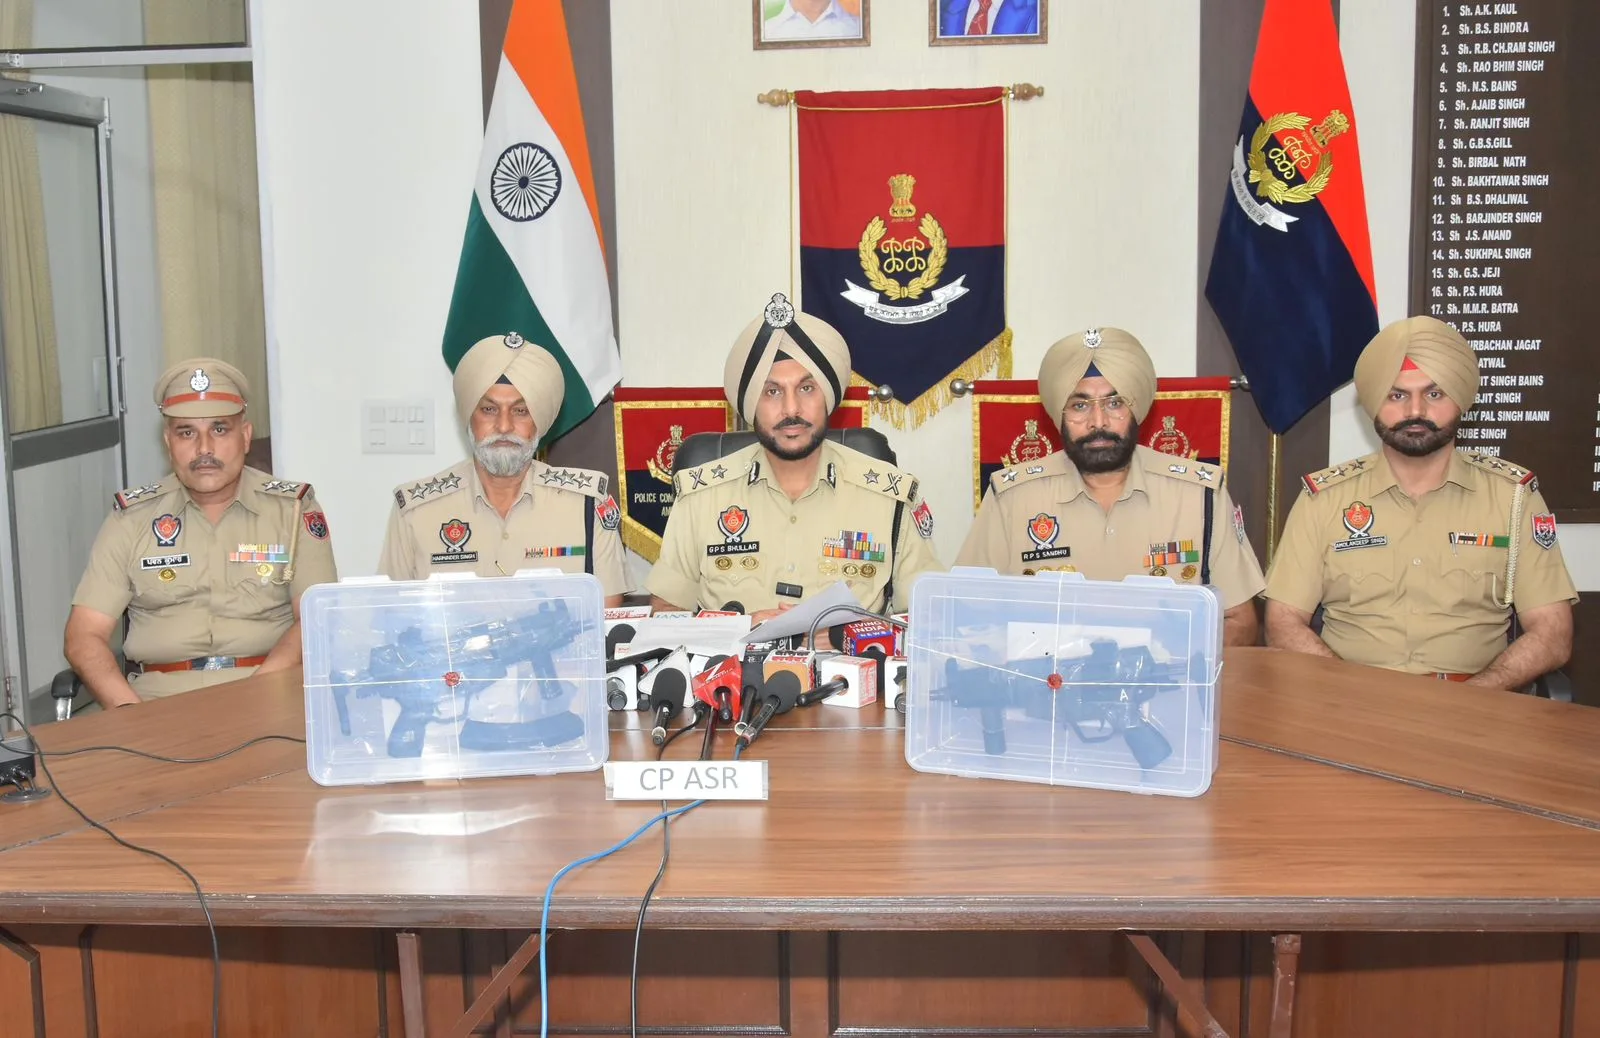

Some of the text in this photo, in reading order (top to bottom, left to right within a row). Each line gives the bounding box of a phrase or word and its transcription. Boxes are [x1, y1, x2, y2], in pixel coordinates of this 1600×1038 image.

[1443, 4, 1517, 17] 1. Sh. A.K. KAUL
[1442, 22, 1529, 35] 2. Sh. B.S. BINDRA
[1441, 41, 1555, 55] 3. Sh. R.B. CH.RAM SINGH
[1440, 60, 1544, 73] 4. Sh. RAO BHIM SINGH
[1440, 80, 1517, 93] 5. Sh. N.S. BAINS
[1439, 98, 1525, 111] 6. Sh. AJAIB SINGH
[1438, 117, 1530, 130] 7. Sh. RANJIT SINGH
[1438, 139, 1446, 149] 8.
[1453, 138, 1467, 149] Sh.
[1438, 156, 1526, 168] 9. Sh. BIRBAL NATH
[1433, 174, 1549, 187] 10. Sh. BAKHTAWAR SINGH
[1432, 195, 1445, 206] 11.
[1467, 194, 1483, 205] B.S.
[1485, 193, 1528, 204] DHALIWAL
[1432, 212, 1542, 224] 12. Sh. BARJINDER SINGH
[1432, 231, 1444, 241] 13.
[1465, 230, 1480, 241] J.S.
[1482, 230, 1512, 240] ANAND
[1432, 248, 1532, 260] 14. Sh. SUKHPAL SINGH
[1432, 267, 1500, 278] 15. Sh. G.S. JEJI
[1432, 285, 1503, 297] 16. Sh. P.S. HURA
[1431, 303, 1518, 314] 17. Sh. M.M.R. BATRA
[1462, 321, 1478, 332] P.S.
[1479, 321, 1502, 332] HURA
[1514, 340, 1542, 350] JAGAT
[1490, 376, 1517, 387] SINGH
[1518, 375, 1544, 386] BAINS
[1495, 392, 1521, 404] SINGH
[1480, 411, 1496, 422] PAL
[1497, 410, 1524, 422] SINGH
[1525, 410, 1550, 421] MANN
[1457, 428, 1507, 440] SUBE SINGH
[634, 493, 656, 503] POLICE
[727, 543, 757, 552] BHULLAR
[1042, 549, 1067, 558] SANDHU
[640, 766, 738, 791] CP ASR
